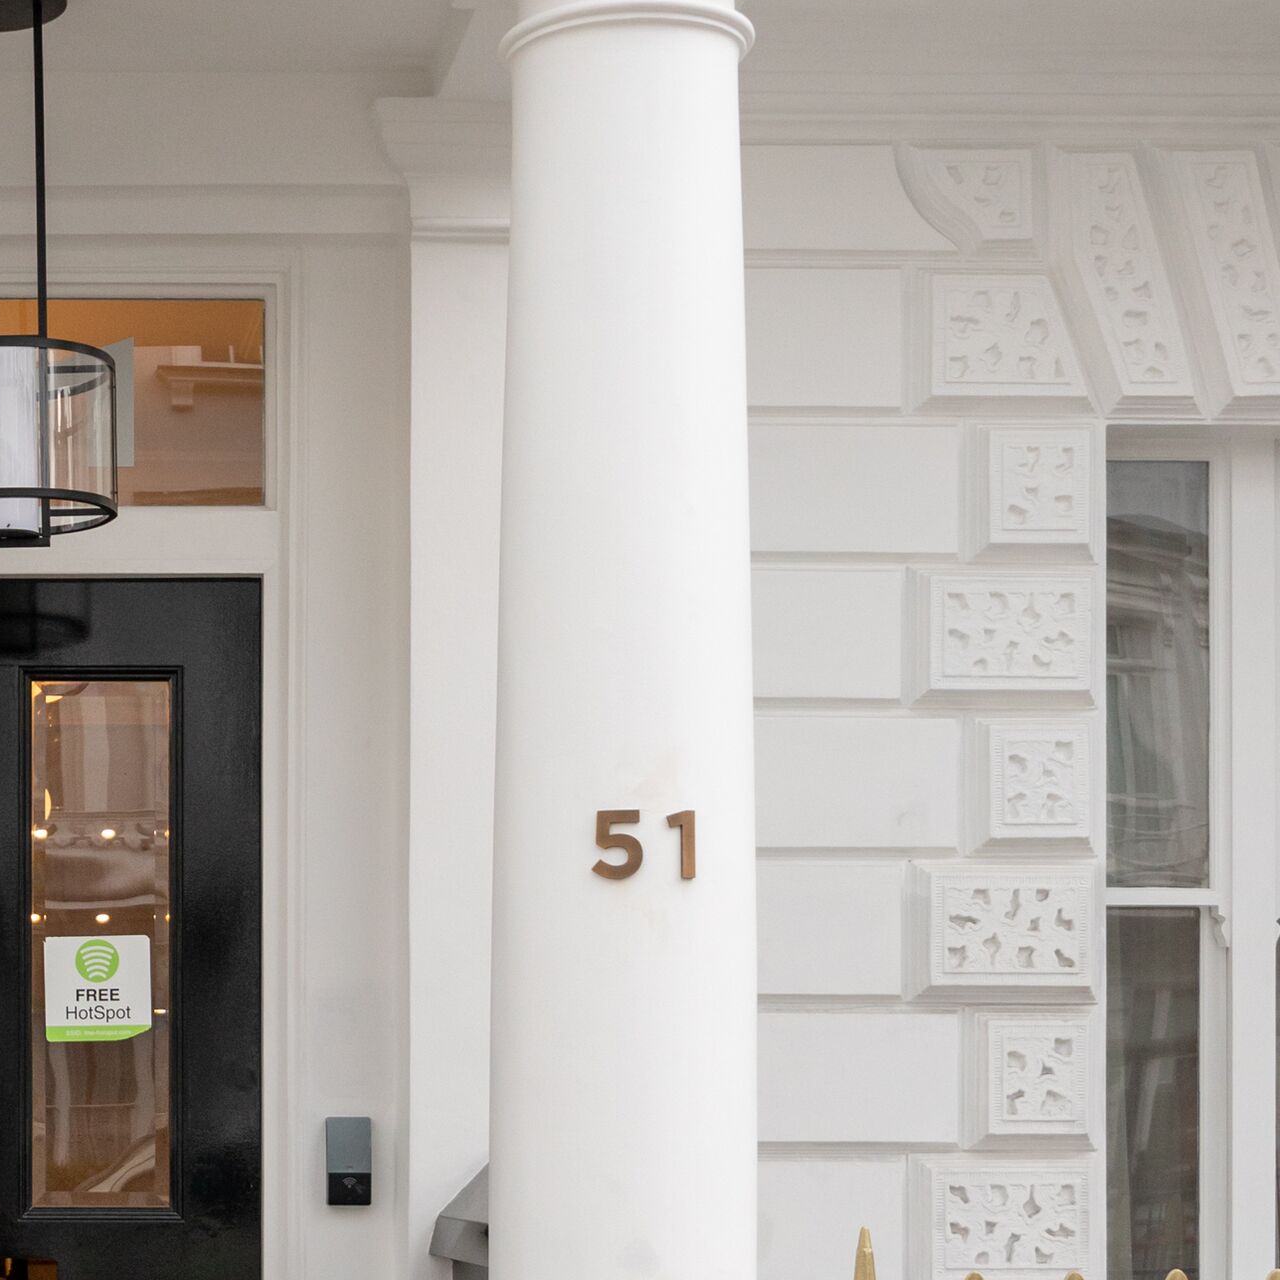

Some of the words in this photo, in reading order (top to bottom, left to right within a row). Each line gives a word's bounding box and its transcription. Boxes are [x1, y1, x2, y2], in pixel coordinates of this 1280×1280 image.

[591, 809, 696, 880] 51
[75, 988, 121, 1002] FREE
[65, 1005, 132, 1023] HotSpot
